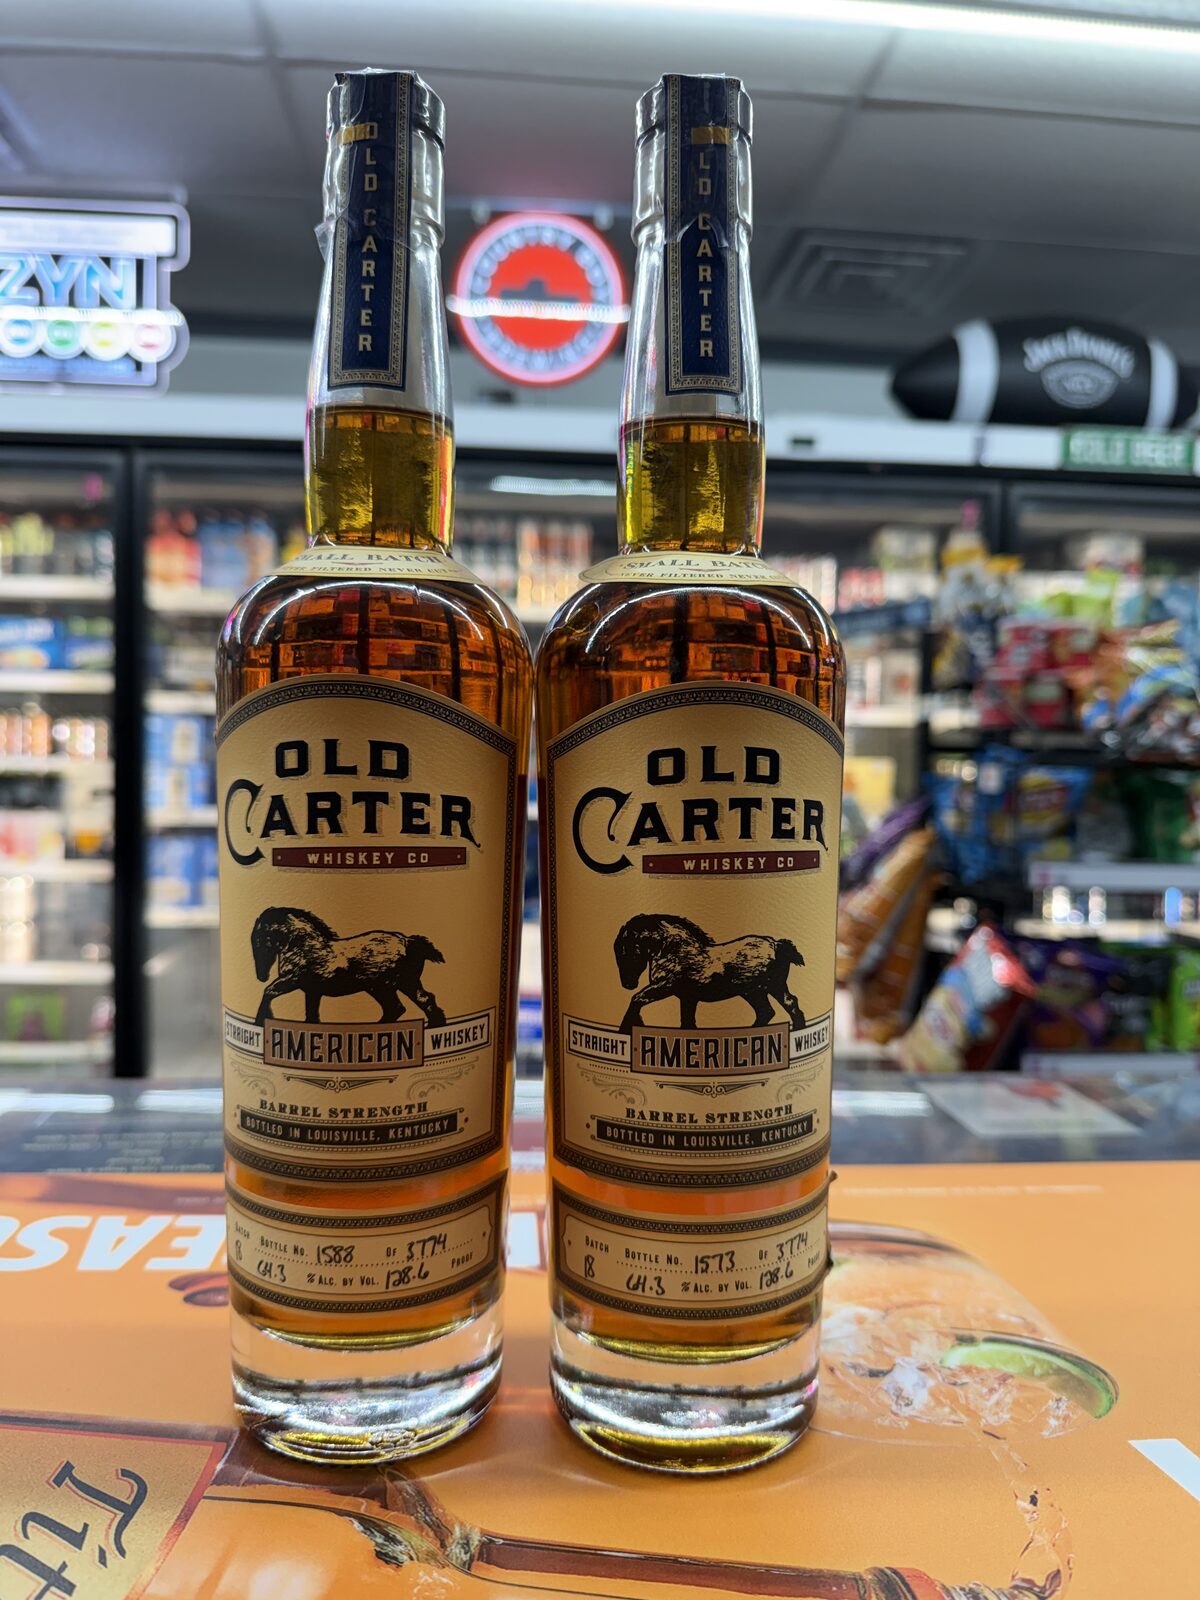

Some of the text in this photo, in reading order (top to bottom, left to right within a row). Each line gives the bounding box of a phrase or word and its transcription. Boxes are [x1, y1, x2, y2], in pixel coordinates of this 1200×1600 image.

[696, 142, 714, 358] LD CARTER
[0, 254, 136, 309] ZYN
[358, 209, 379, 352] CARTER
[368, 554, 441, 564] BATCH
[625, 560, 699, 570] SMALL
[275, 739, 410, 779] OLD
[647, 745, 781, 786] OLD
[225, 778, 481, 866] CARTER
[572, 786, 829, 874] CARTER
[307, 852, 430, 866] WHISKEY CO
[683, 856, 795, 871] WHISKEY CO
[226, 1021, 261, 1047] STRAIGHT
[271, 1028, 415, 1064] AMERICAN
[431, 1023, 486, 1050] WHISKEY
[572, 1030, 627, 1056] STRAIGHT
[795, 1026, 828, 1052] WHISKEY
[641, 1033, 783, 1069] AMERICAN
[260, 1099, 428, 1119] BARREL STRENGTH
[625, 1103, 793, 1124] BARREL STRENGTH
[245, 1116, 450, 1142] BOTTLED IN LOUISVILLE, KENTUCKY
[606, 1121, 808, 1147] BOTTLED IN LOUISVILLE, KENTUCKY
[260, 1236, 288, 1254] BOTTLE
[316, 1244, 355, 1265] 1588
[386, 1246, 398, 1258] OF
[585, 1235, 609, 1254] BATCH
[624, 1247, 660, 1264] BOTTLE
[694, 1250, 736, 1274] 1573
[758, 1248, 769, 1260] OF
[776, 1231, 808, 1260] 3774
[342, 1276, 354, 1286] BY
[385, 1262, 429, 1290] 128.6
[451, 1252, 474, 1269] PROOF
[718, 1282, 730, 1292] BY
[759, 1262, 794, 1290] 128.6
